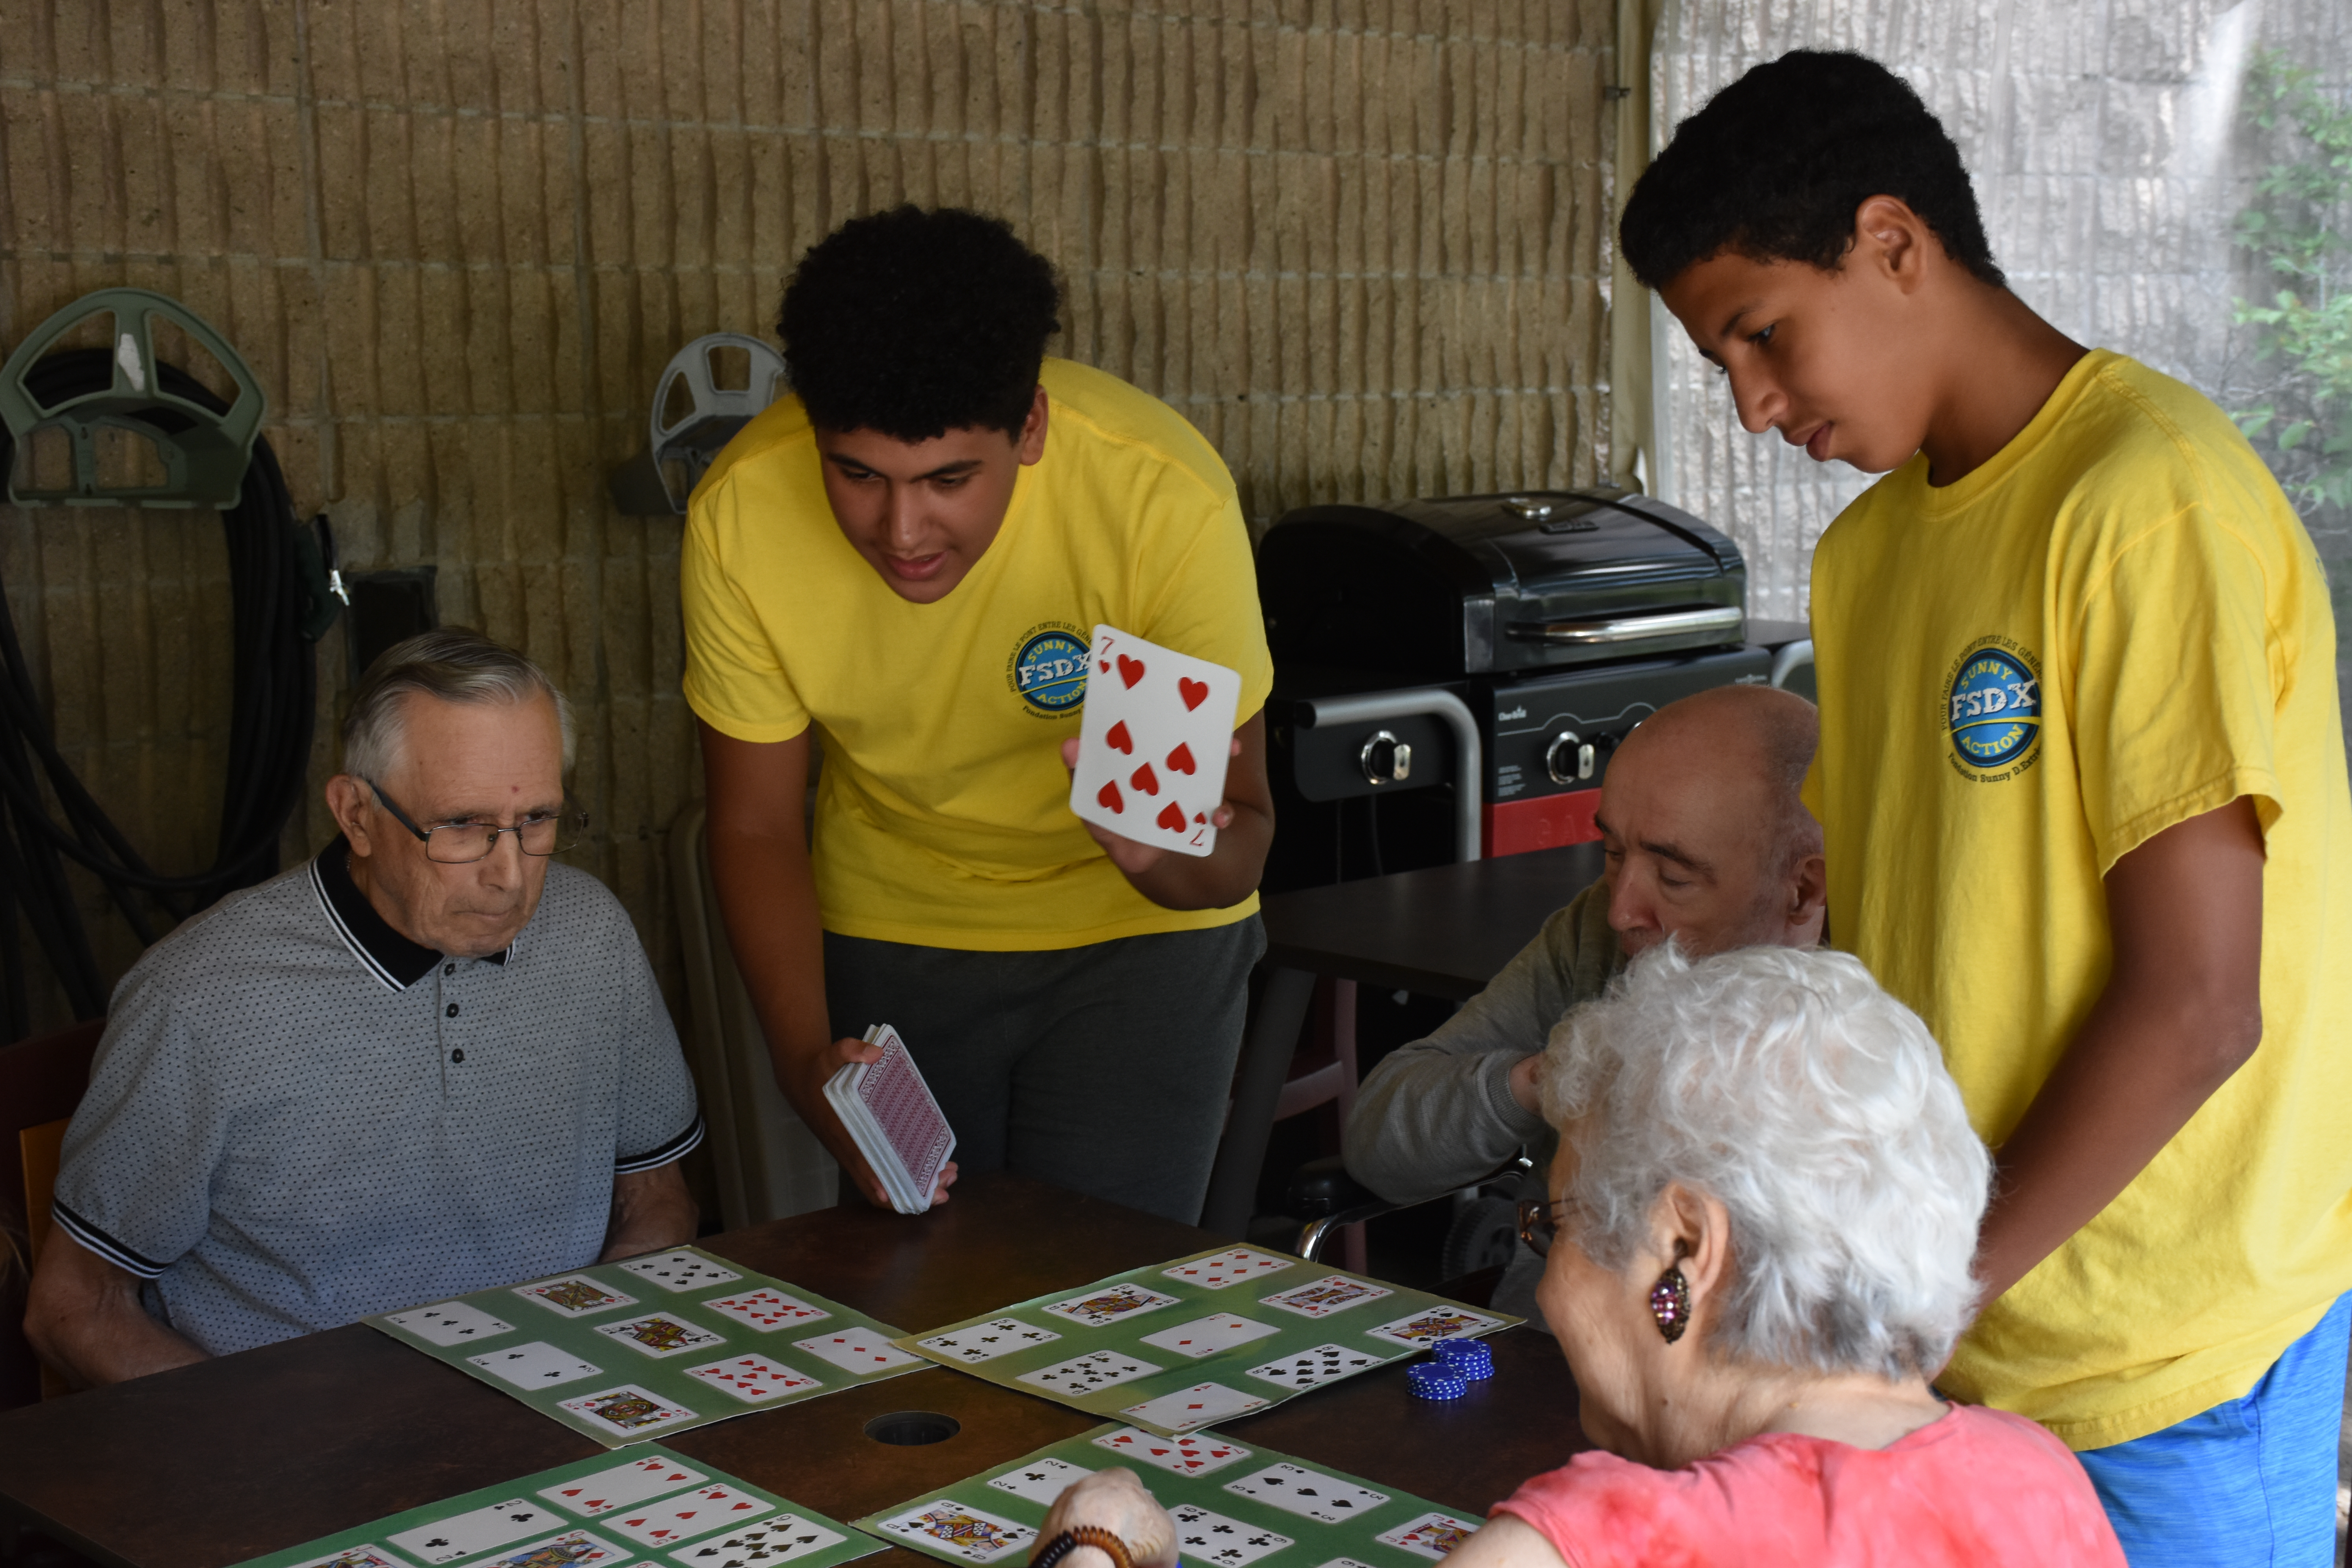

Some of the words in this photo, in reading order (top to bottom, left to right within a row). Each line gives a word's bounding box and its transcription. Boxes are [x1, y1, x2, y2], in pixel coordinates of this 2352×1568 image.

[1020, 626, 1037, 642] PONT
[1038, 621, 1061, 630] ENTRE
[1063, 622, 1076, 632] LES
[1013, 641, 1022, 651] LE
[1028, 640, 1075, 663] SUNNY
[1101, 636, 1115, 655] 7
[1006, 651, 1016, 672] FAIRE
[1018, 650, 1092, 687] FSDX
[1942, 671, 1953, 700] FAIRE
[1951, 659, 1960, 672] LE
[1959, 640, 1977, 661] PONT
[1978, 635, 2002, 646] ENTRE
[2002, 637, 2018, 651] LES
[1006, 674, 1016, 692] POUR
[1961, 661, 2013, 690] SUNNY
[1037, 681, 1087, 704] ACTION
[1951, 677, 2037, 722] FSDX
[1023, 705, 1057, 719] Fondation
[1060, 709, 1081, 719] Sunny
[1962, 724, 2024, 755] ACTION
[1948, 752, 1977, 782] Fondation
[1980, 771, 2011, 782] Sunny
[1189, 829, 1205, 847] 7
